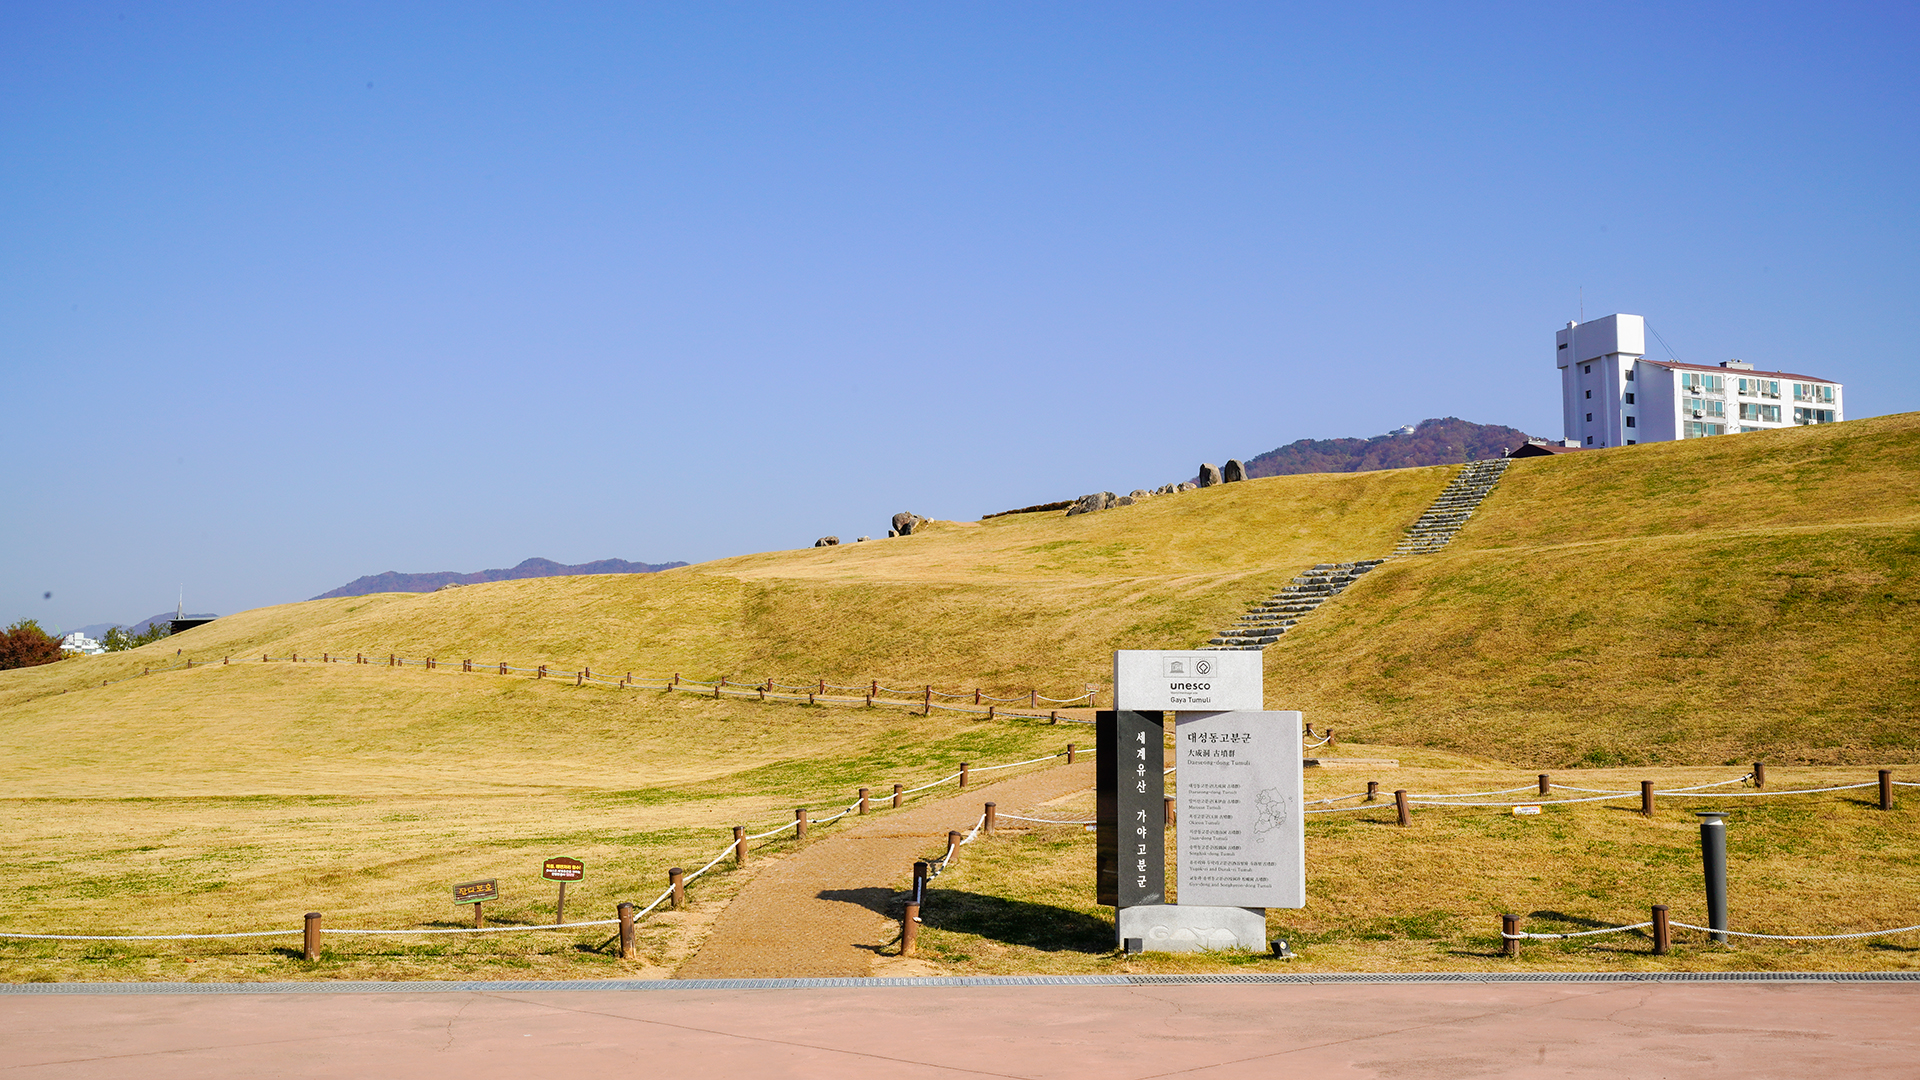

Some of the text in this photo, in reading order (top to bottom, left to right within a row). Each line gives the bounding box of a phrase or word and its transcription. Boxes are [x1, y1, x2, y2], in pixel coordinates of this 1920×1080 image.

[1170, 682, 1211, 690] unesco
[1170, 696, 1187, 704] Gaya
[1187, 732, 1251, 743] 대성동고분군
[1136, 731, 1147, 888] 세계유산 가야고분군
